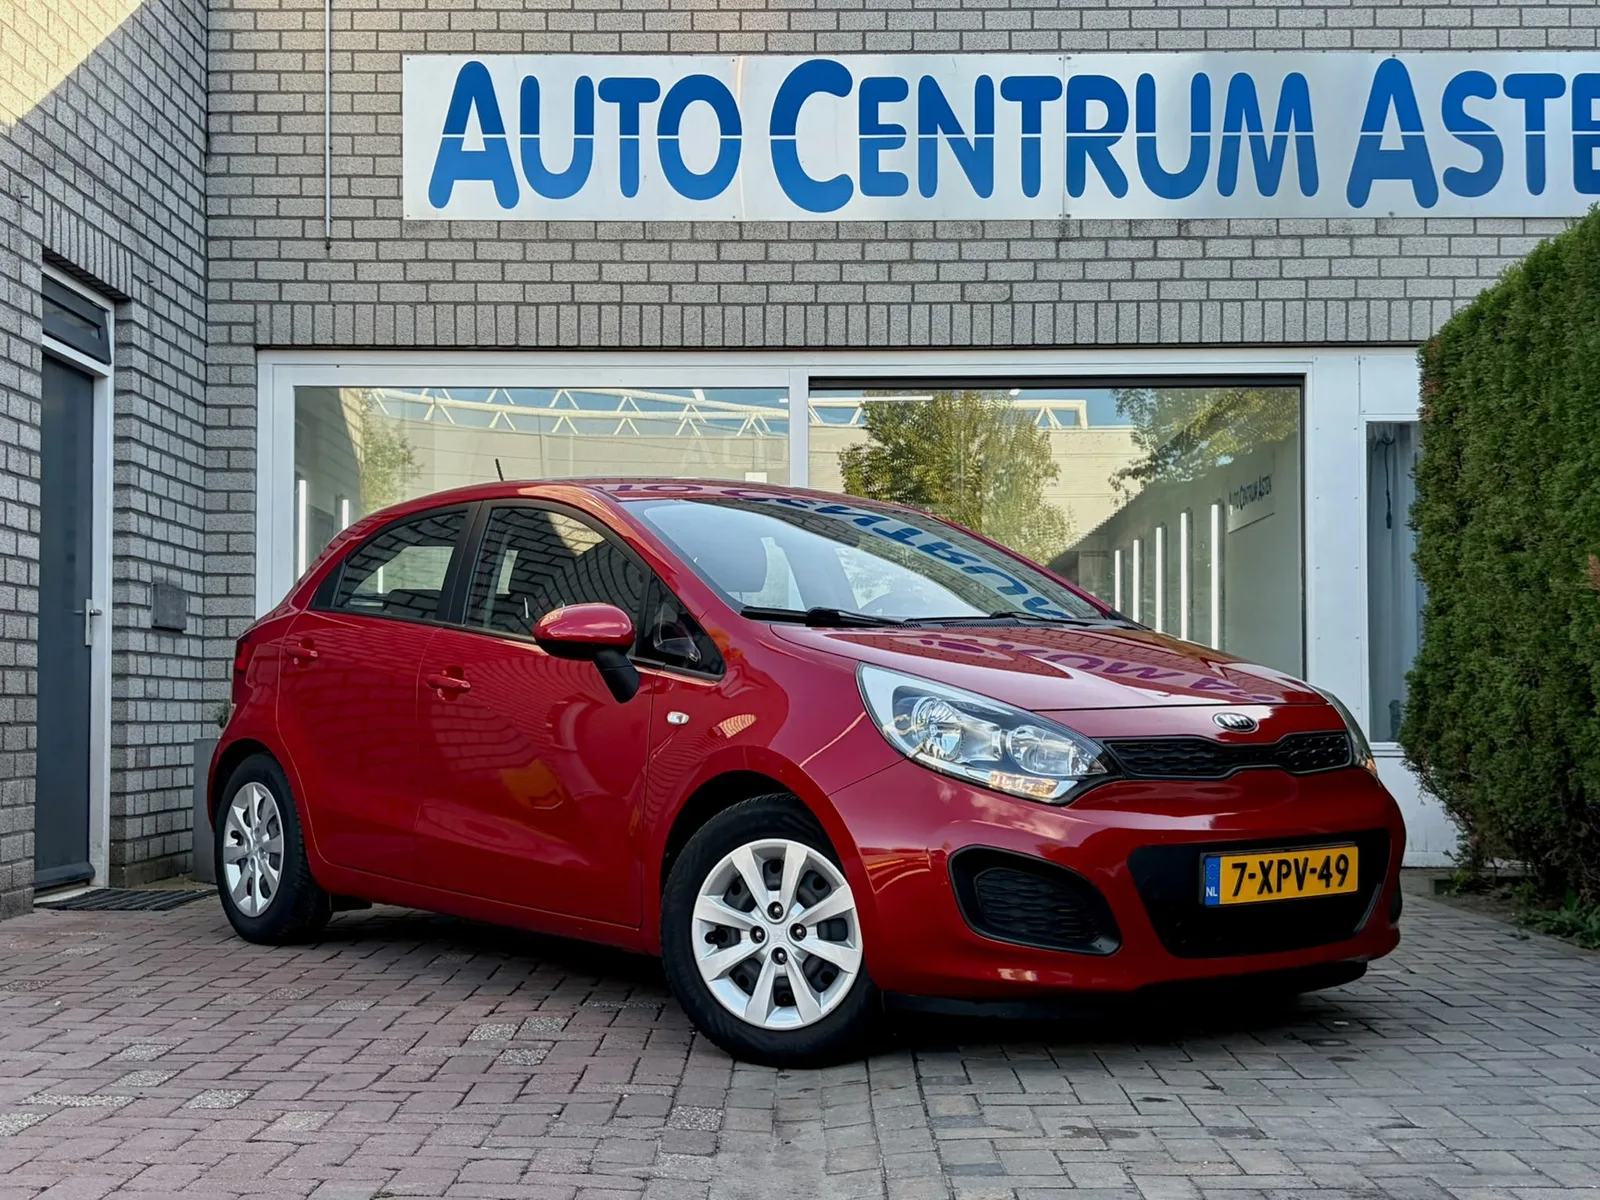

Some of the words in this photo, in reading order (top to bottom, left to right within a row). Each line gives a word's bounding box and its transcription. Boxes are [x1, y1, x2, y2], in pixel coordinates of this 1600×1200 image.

[428, 60, 743, 210] AUTO
[769, 58, 1320, 214] CENTRUM
[1205, 886, 1219, 897] NL
[1231, 853, 1350, 897] 7-XPV-49
